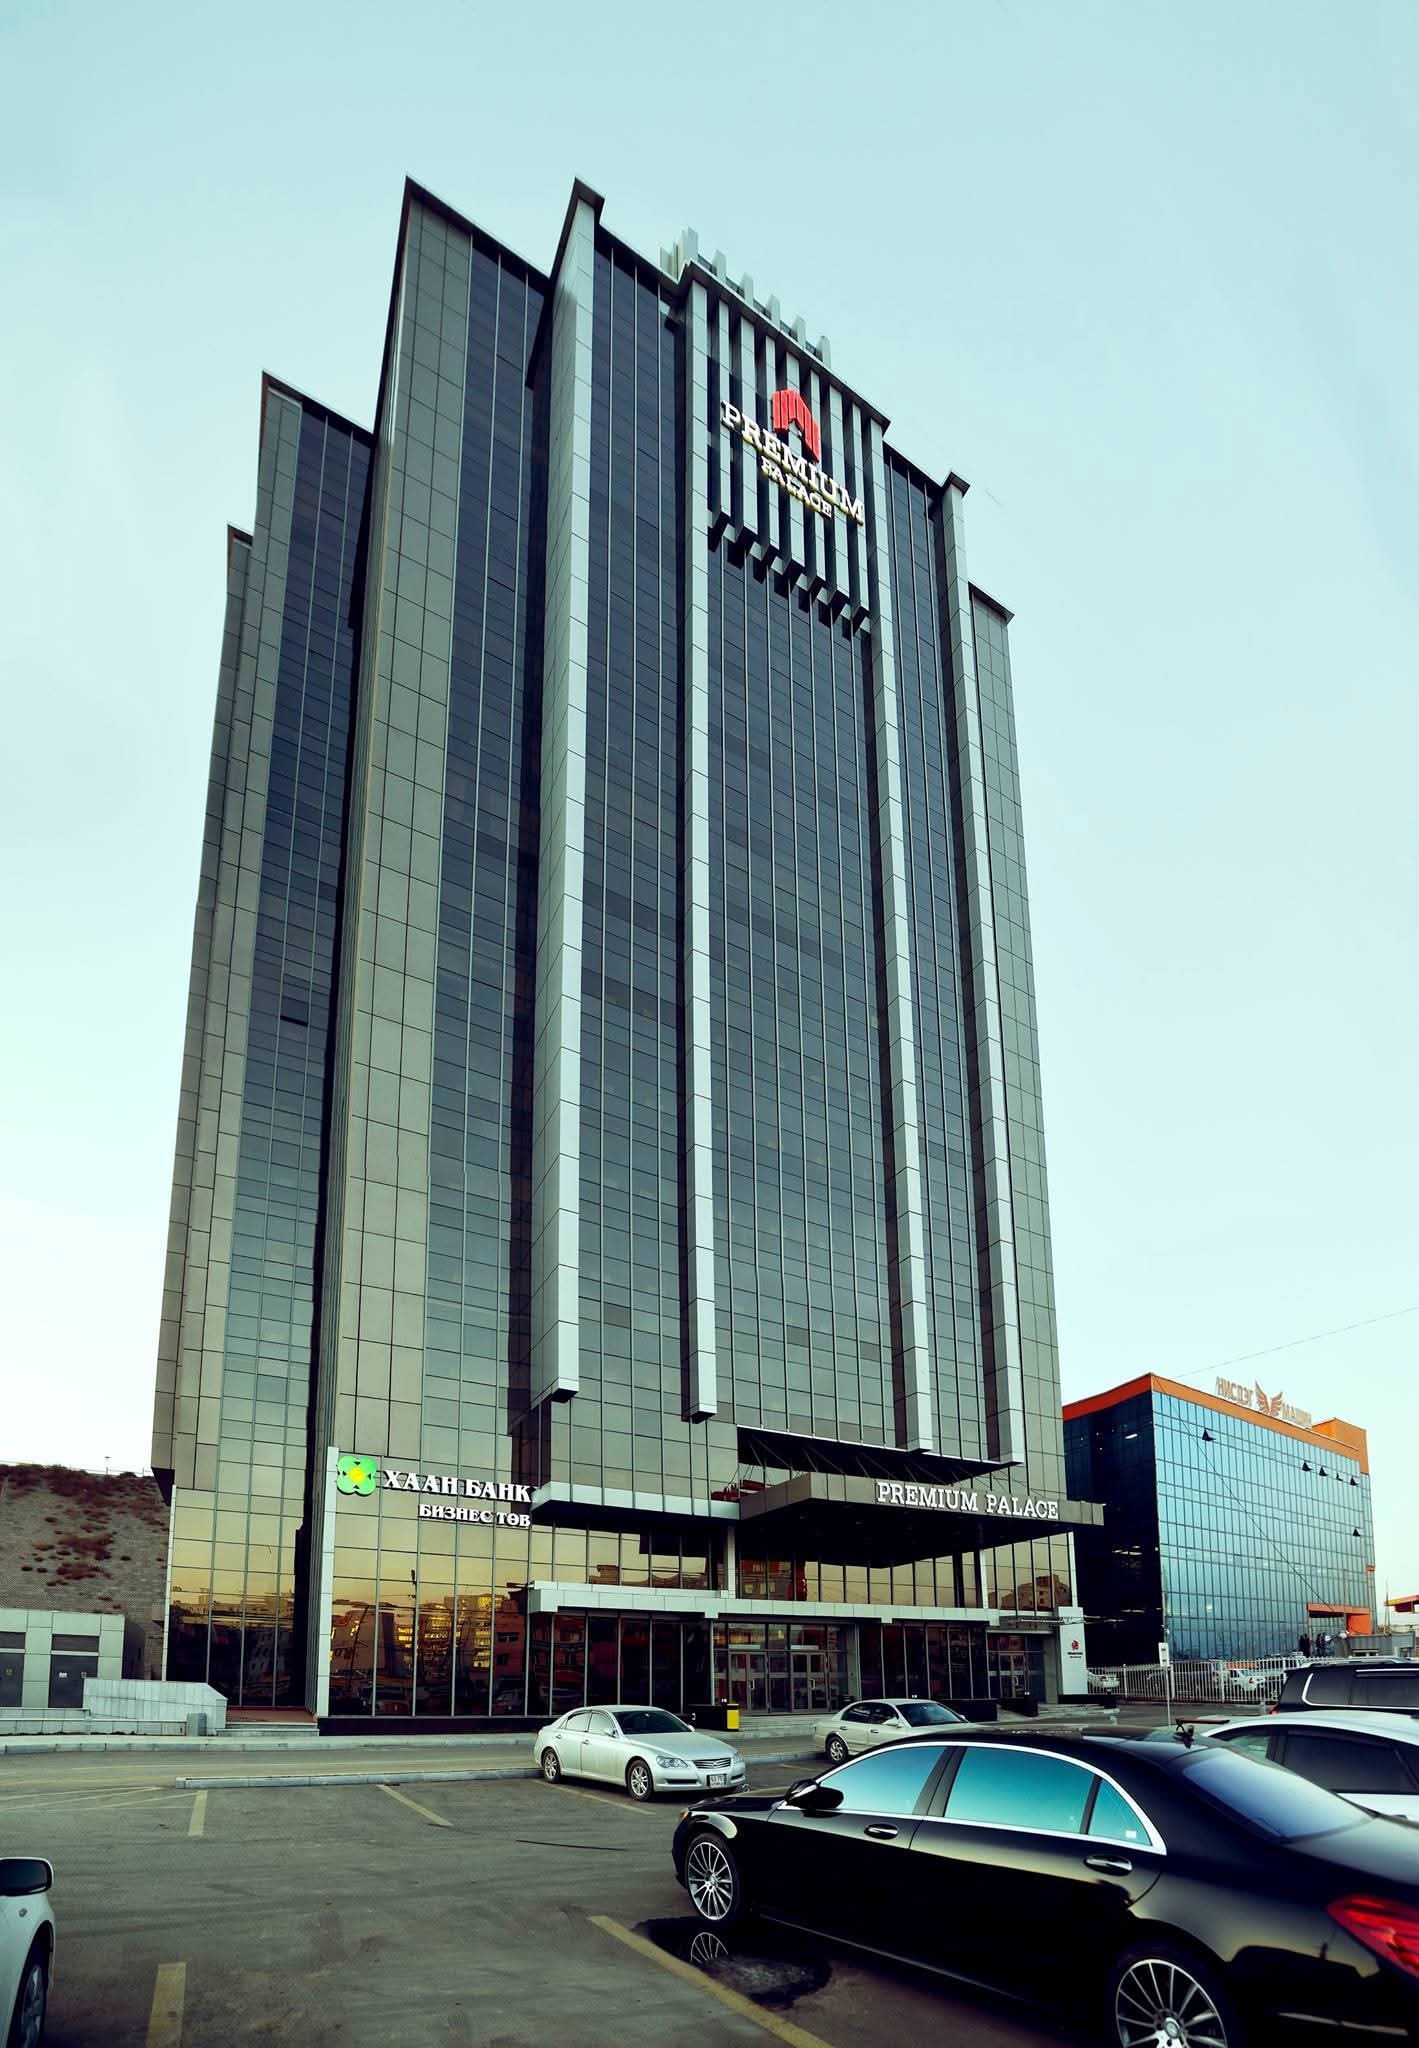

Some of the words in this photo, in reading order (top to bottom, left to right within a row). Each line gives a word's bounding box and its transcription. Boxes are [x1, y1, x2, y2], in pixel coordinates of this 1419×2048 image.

[721, 399, 865, 526] PREMIUM
[760, 455, 832, 518] PALACE
[383, 1469, 459, 1496] ХААН
[464, 1479, 531, 1503] БАНК
[877, 1481, 978, 1513] PREMIUM
[986, 1493, 1058, 1519] PALACE
[418, 1503, 493, 1523] БИЗНЕС
[496, 1513, 531, 1527] ТӨВ
